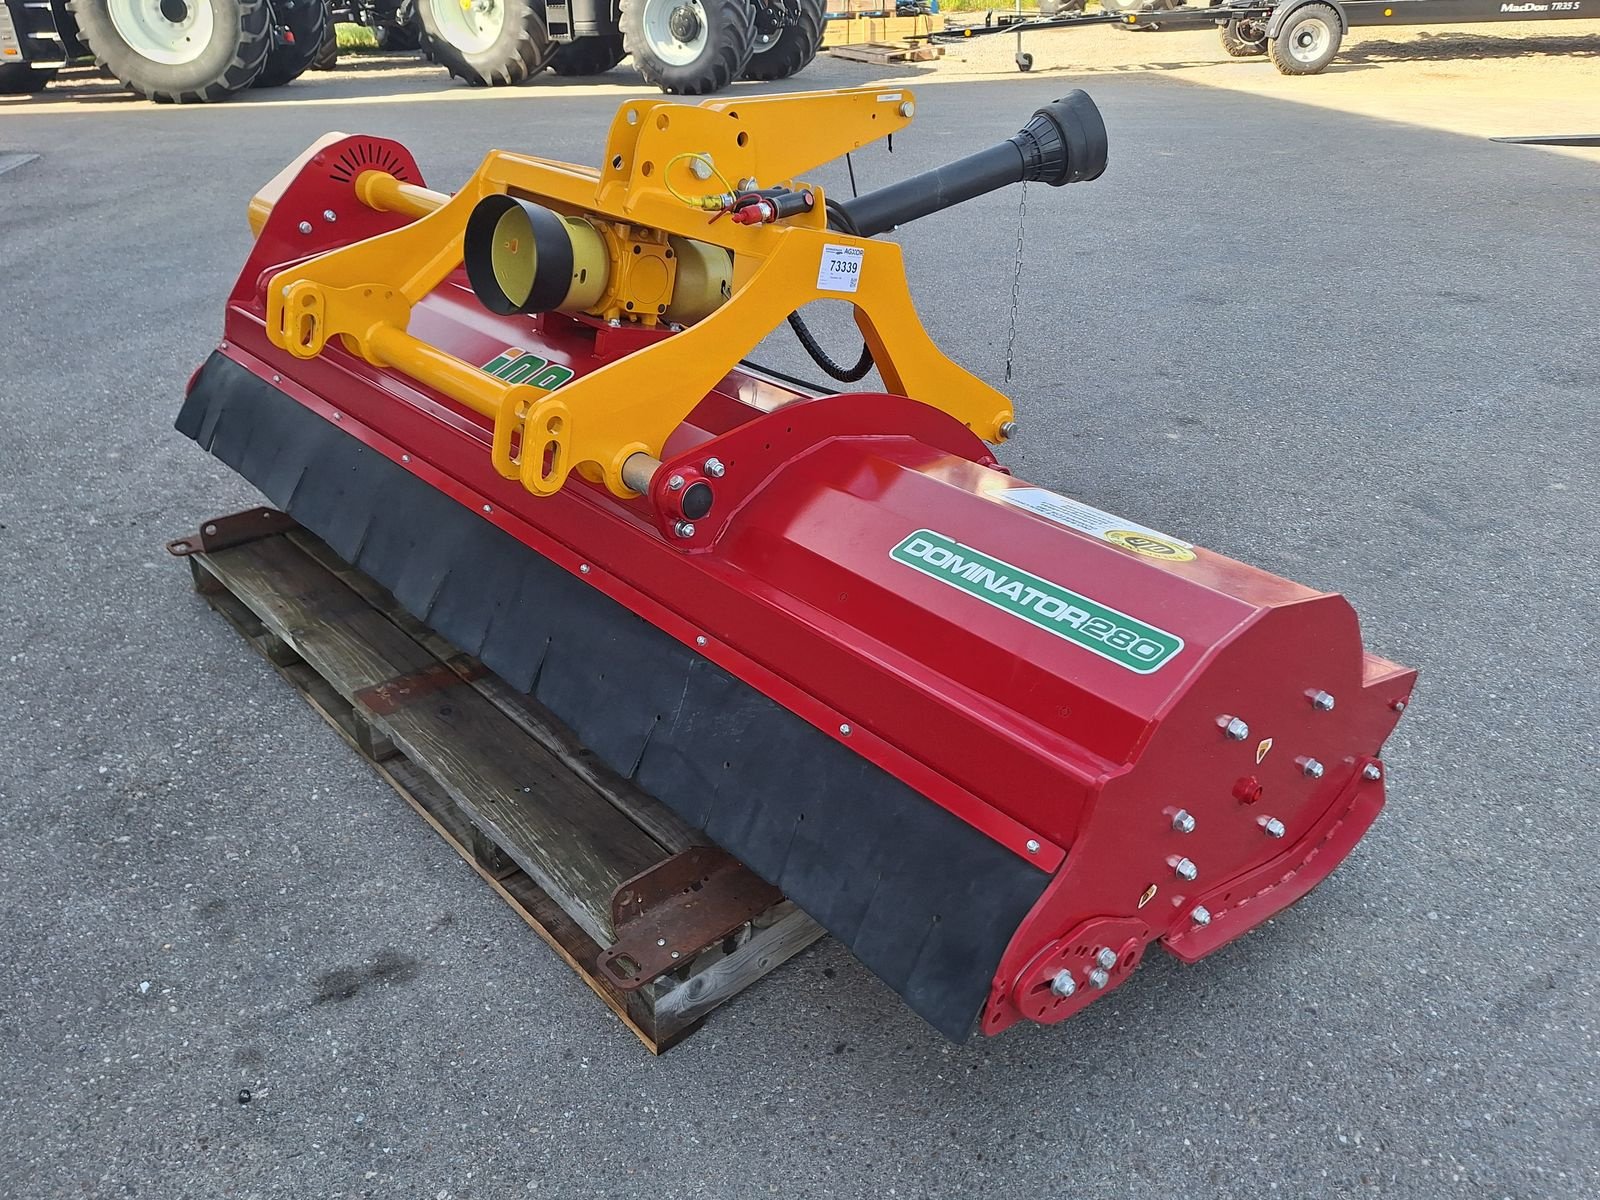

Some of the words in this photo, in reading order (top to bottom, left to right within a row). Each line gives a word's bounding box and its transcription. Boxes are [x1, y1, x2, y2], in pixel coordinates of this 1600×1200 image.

[1500, 3, 1549, 12] MacDon
[1551, 2, 1572, 11] TR35
[1572, 2, 1581, 10] S
[830, 260, 858, 274] 73339
